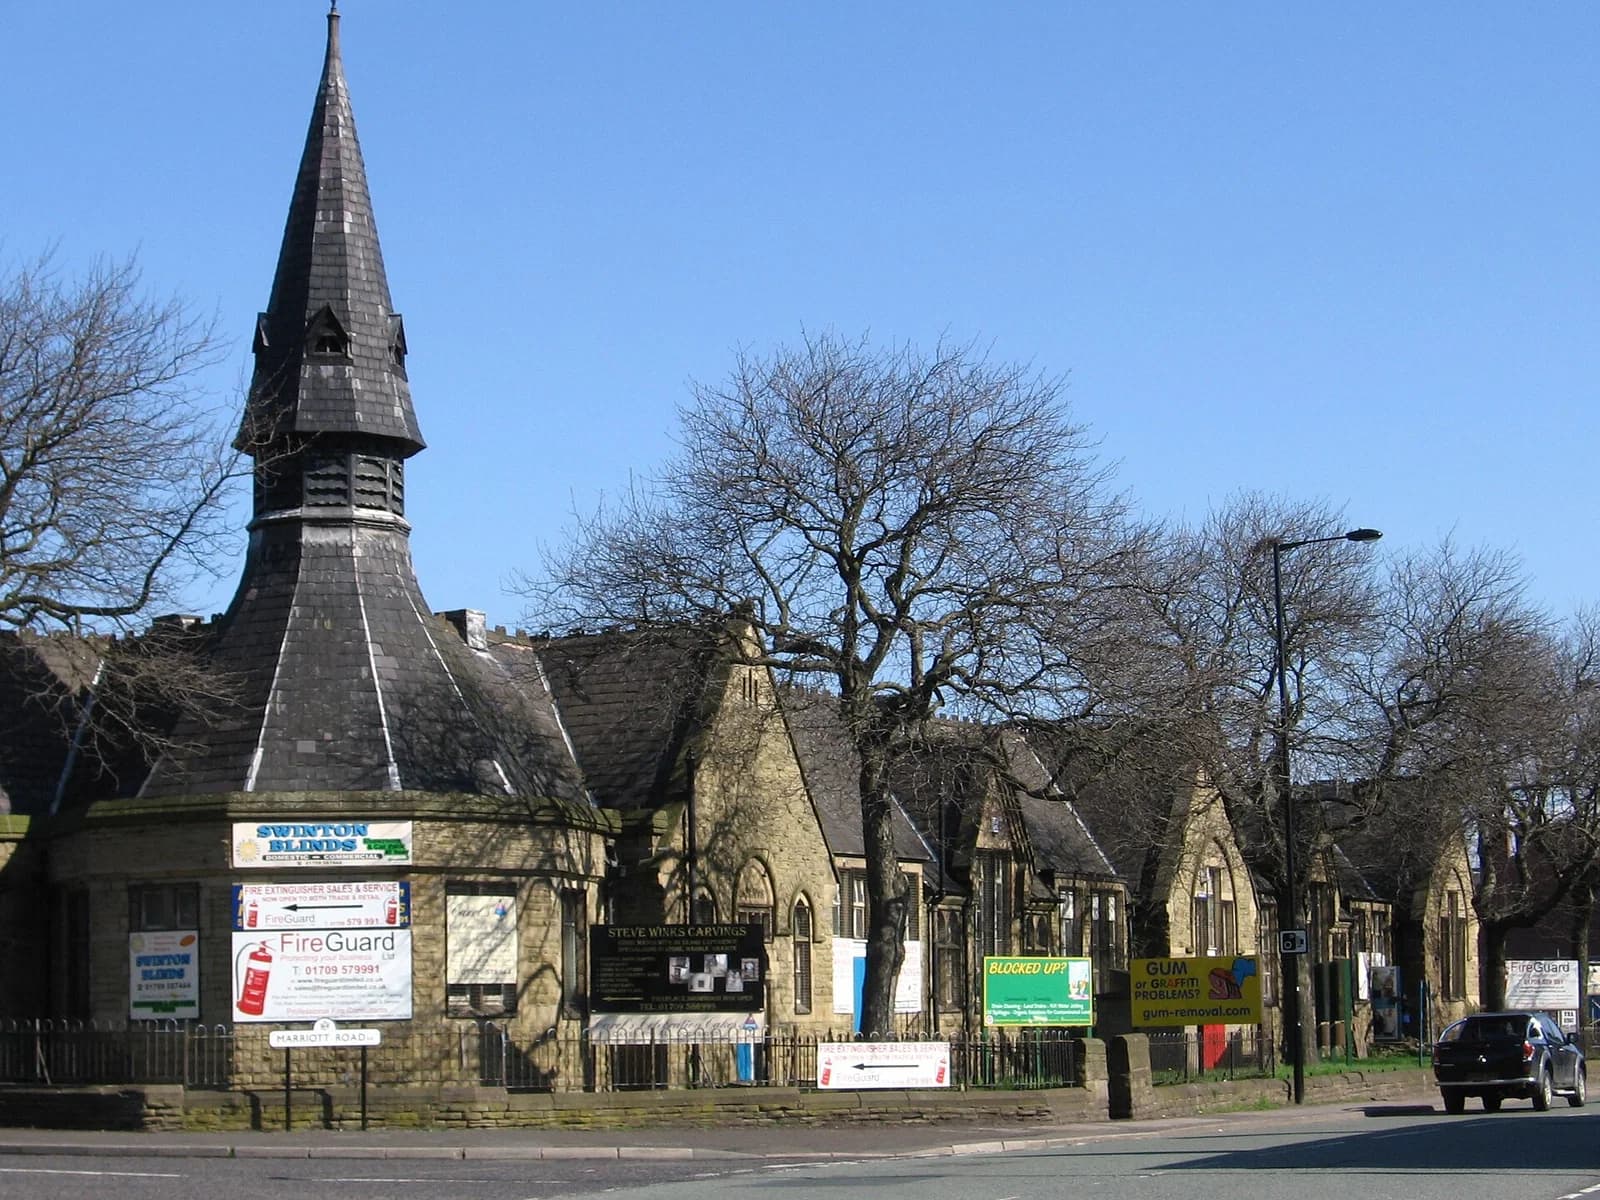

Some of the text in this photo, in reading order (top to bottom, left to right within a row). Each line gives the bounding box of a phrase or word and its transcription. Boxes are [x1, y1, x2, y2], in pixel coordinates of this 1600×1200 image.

[257, 824, 369, 838] SWINTON
[269, 839, 358, 852] BLINDS
[244, 883, 398, 895] FIRE EXTINGUISHER SALES & SERVICE
[264, 914, 315, 924] FireGuard
[608, 926, 747, 938] STEVE WINKS CARVINGS
[280, 931, 395, 952] FireGuard
[136, 953, 191, 967] SWINTON
[280, 954, 318, 963] Protecting
[320, 955, 337, 963] your
[382, 953, 395, 961] Ltd
[305, 965, 338, 975] 01709
[341, 964, 380, 974] 579991
[989, 962, 1068, 975] BLOCKED UP?
[1146, 961, 1188, 975] GUM
[1511, 962, 1570, 973] FireGuard
[141, 968, 184, 980] BLINDS
[1135, 977, 1199, 989] or GRAFFITI
[1135, 989, 1201, 1000] PROBLEMS?
[1143, 1006, 1250, 1020] gum-removal.com
[276, 1033, 329, 1043] MARRIOTT
[335, 1033, 366, 1042] ROAD
